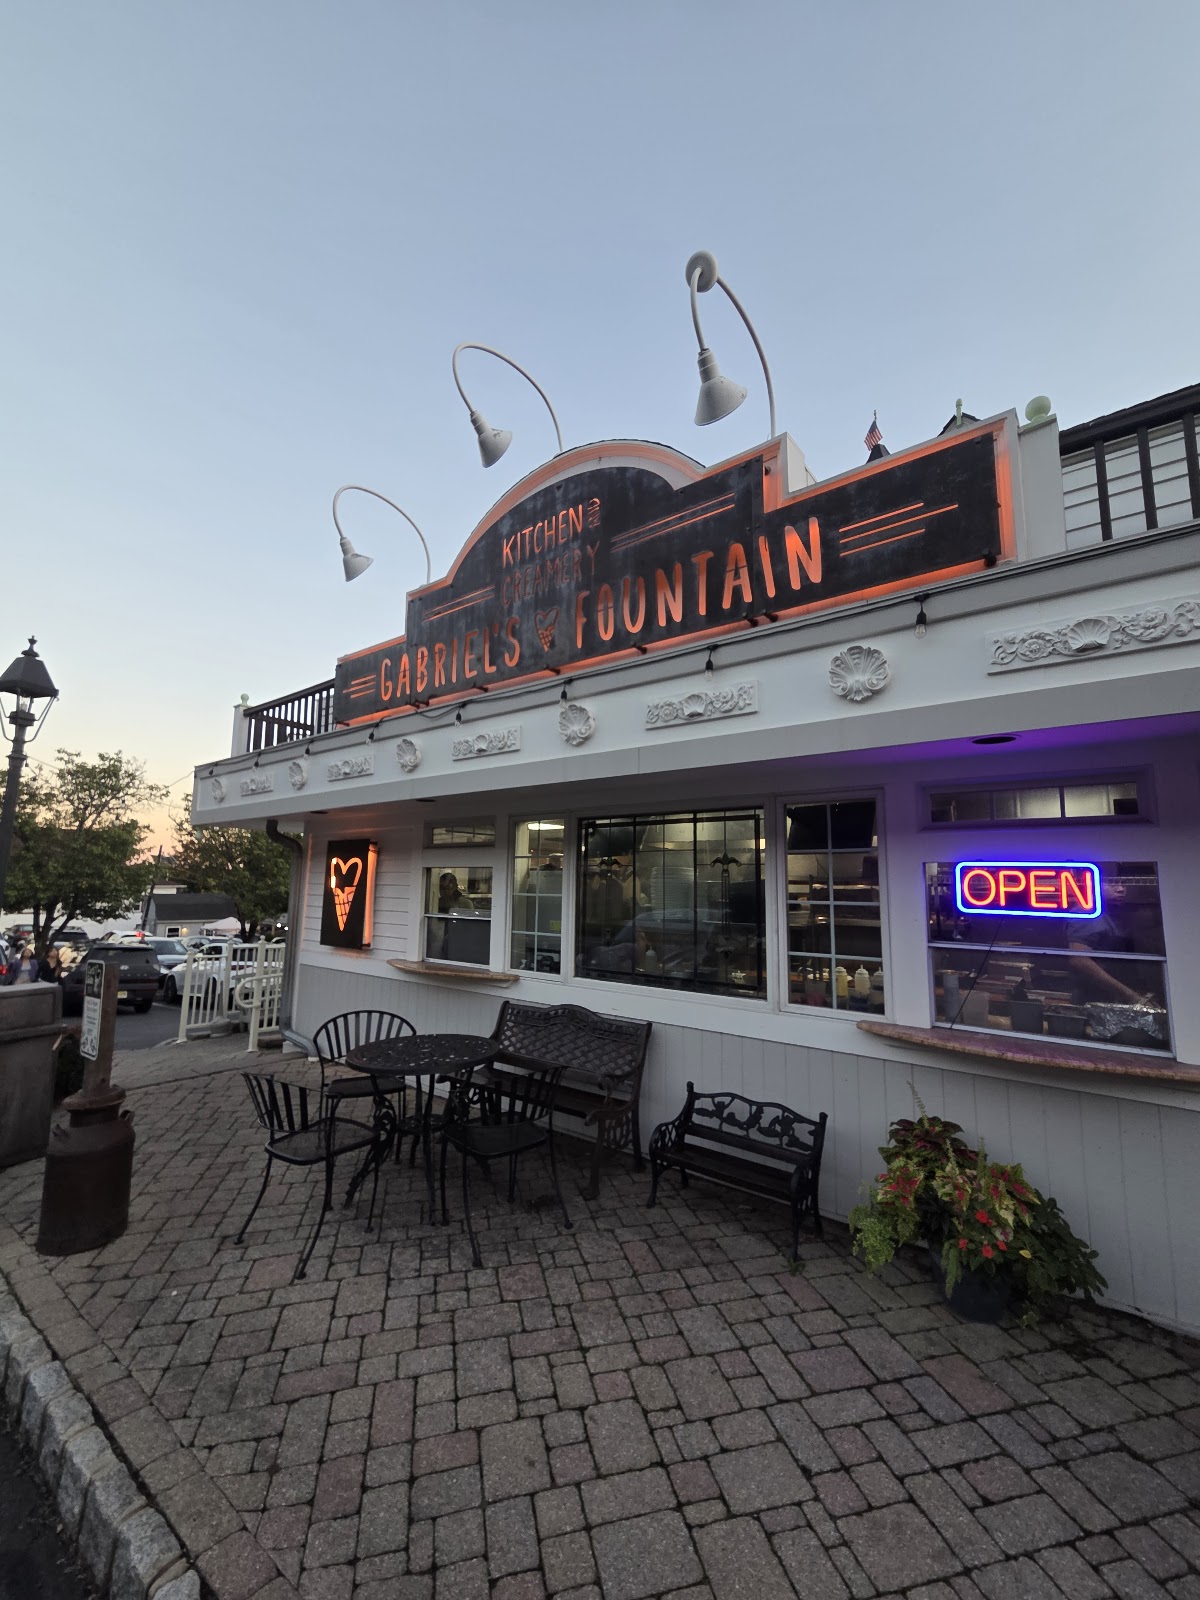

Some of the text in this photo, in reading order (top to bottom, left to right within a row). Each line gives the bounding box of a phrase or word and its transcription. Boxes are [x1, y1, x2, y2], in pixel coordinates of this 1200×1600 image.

[503, 504, 583, 568] KITCHEN
[501, 541, 600, 609] CREAMERY
[380, 517, 822, 701] GABRIEL'S FOUNTAIN
[963, 869, 1093, 910] OPEN
